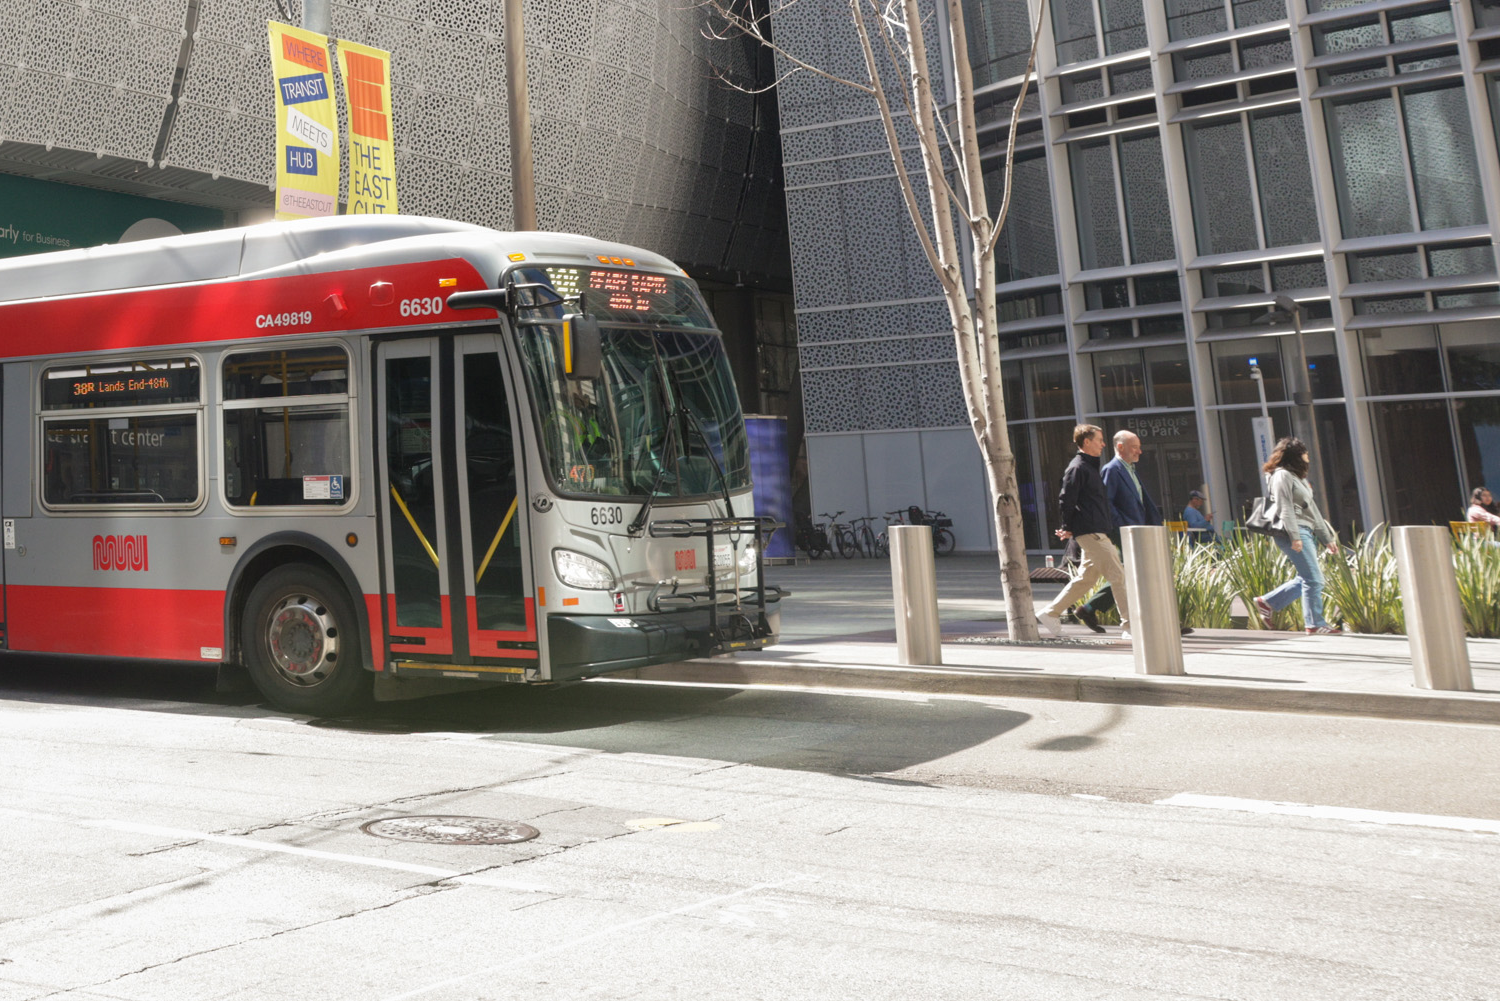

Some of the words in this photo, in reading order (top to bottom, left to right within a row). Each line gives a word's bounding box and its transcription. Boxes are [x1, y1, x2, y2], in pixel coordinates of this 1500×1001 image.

[286, 41, 324, 67] WHERE
[283, 78, 323, 100] TRANSIT
[292, 115, 329, 148] MEETS
[290, 152, 313, 169] HUB
[353, 141, 381, 170] THE
[355, 170, 392, 200] EAST
[283, 195, 332, 213] @THEEASTCUT
[22, 231, 34, 242] for
[36, 233, 70, 247] Business
[400, 296, 443, 318] 6630
[256, 310, 312, 328] CA49819
[73, 382, 95, 396] 38R
[98, 381, 126, 393] Lands
[128, 377, 169, 391] End-48th
[1127, 416, 1188, 429] Elevators
[1136, 427, 1148, 437] to
[1152, 425, 1180, 437] Park
[591, 506, 622, 525] 6630
